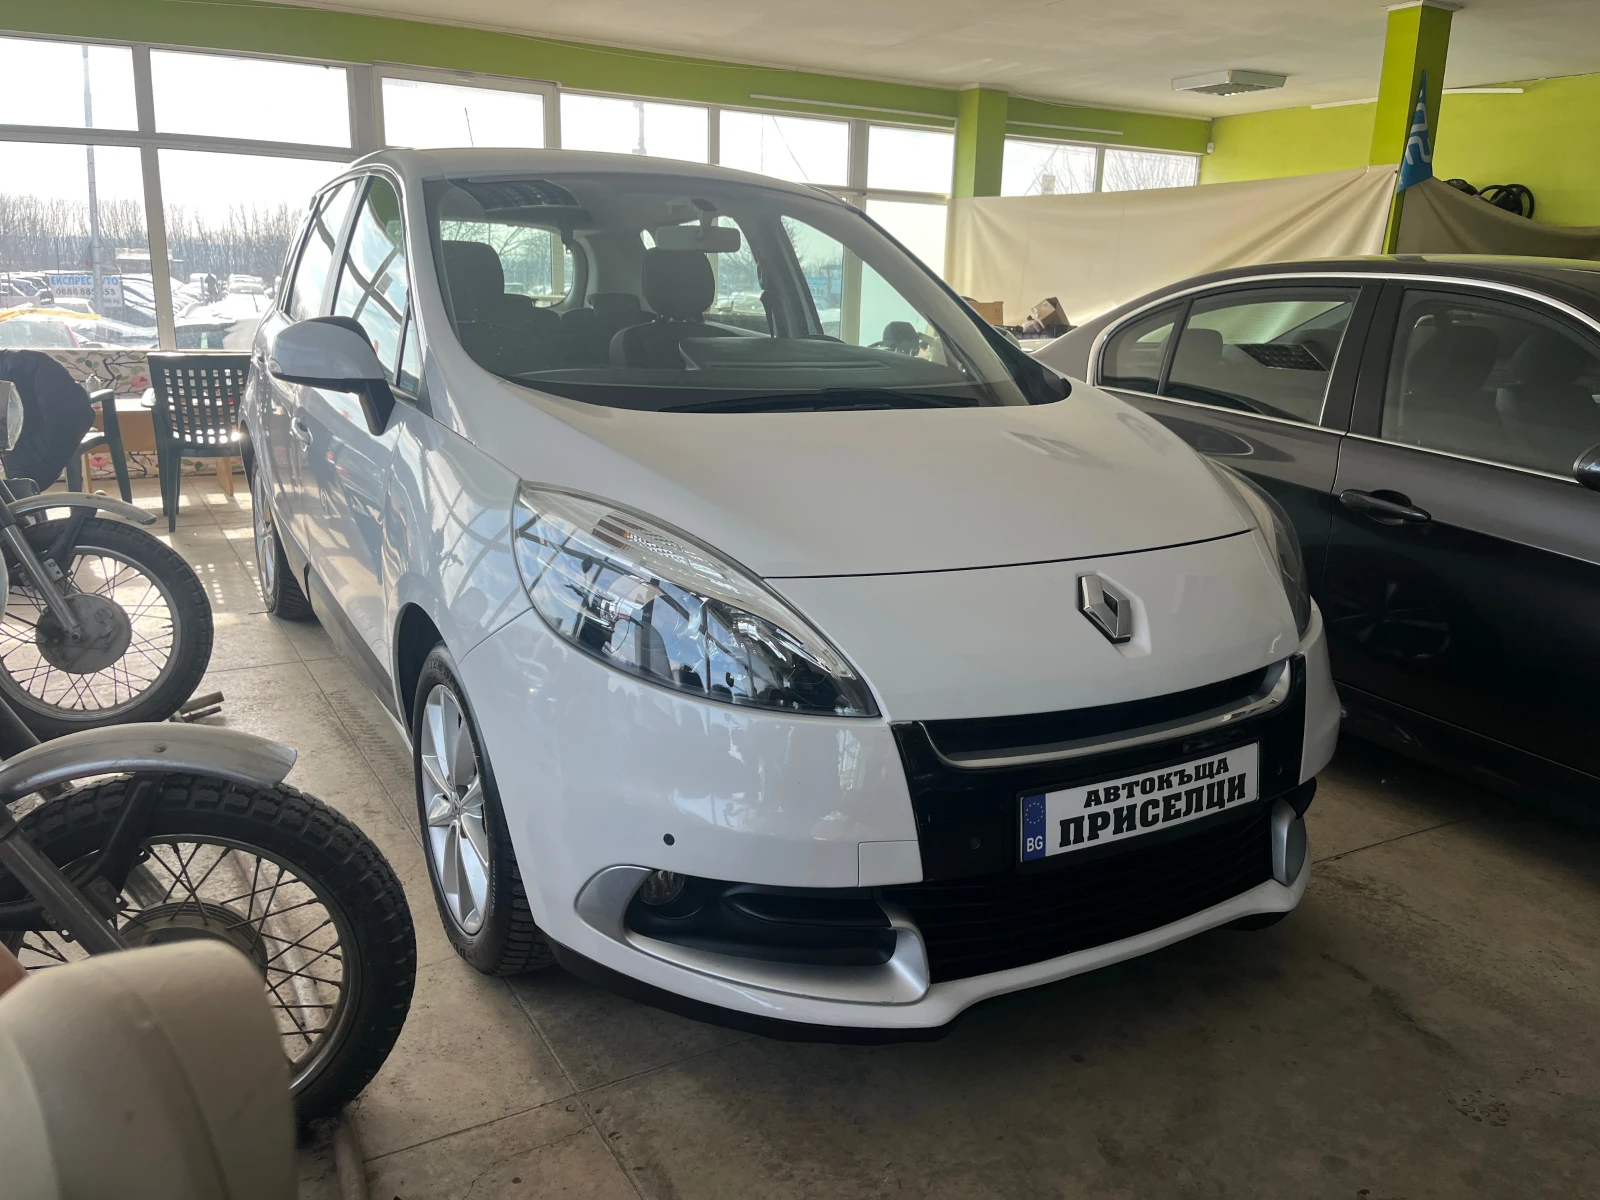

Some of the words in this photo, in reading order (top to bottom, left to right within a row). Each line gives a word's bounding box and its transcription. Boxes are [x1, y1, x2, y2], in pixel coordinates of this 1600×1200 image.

[51, 276, 92, 286] ЕКСПРЕС
[56, 288, 78, 296] 0888
[1084, 757, 1229, 808] АВТОКЪЩА
[1059, 773, 1247, 848] ПРИСЕЛЦИ
[1026, 835, 1043, 853] BG
